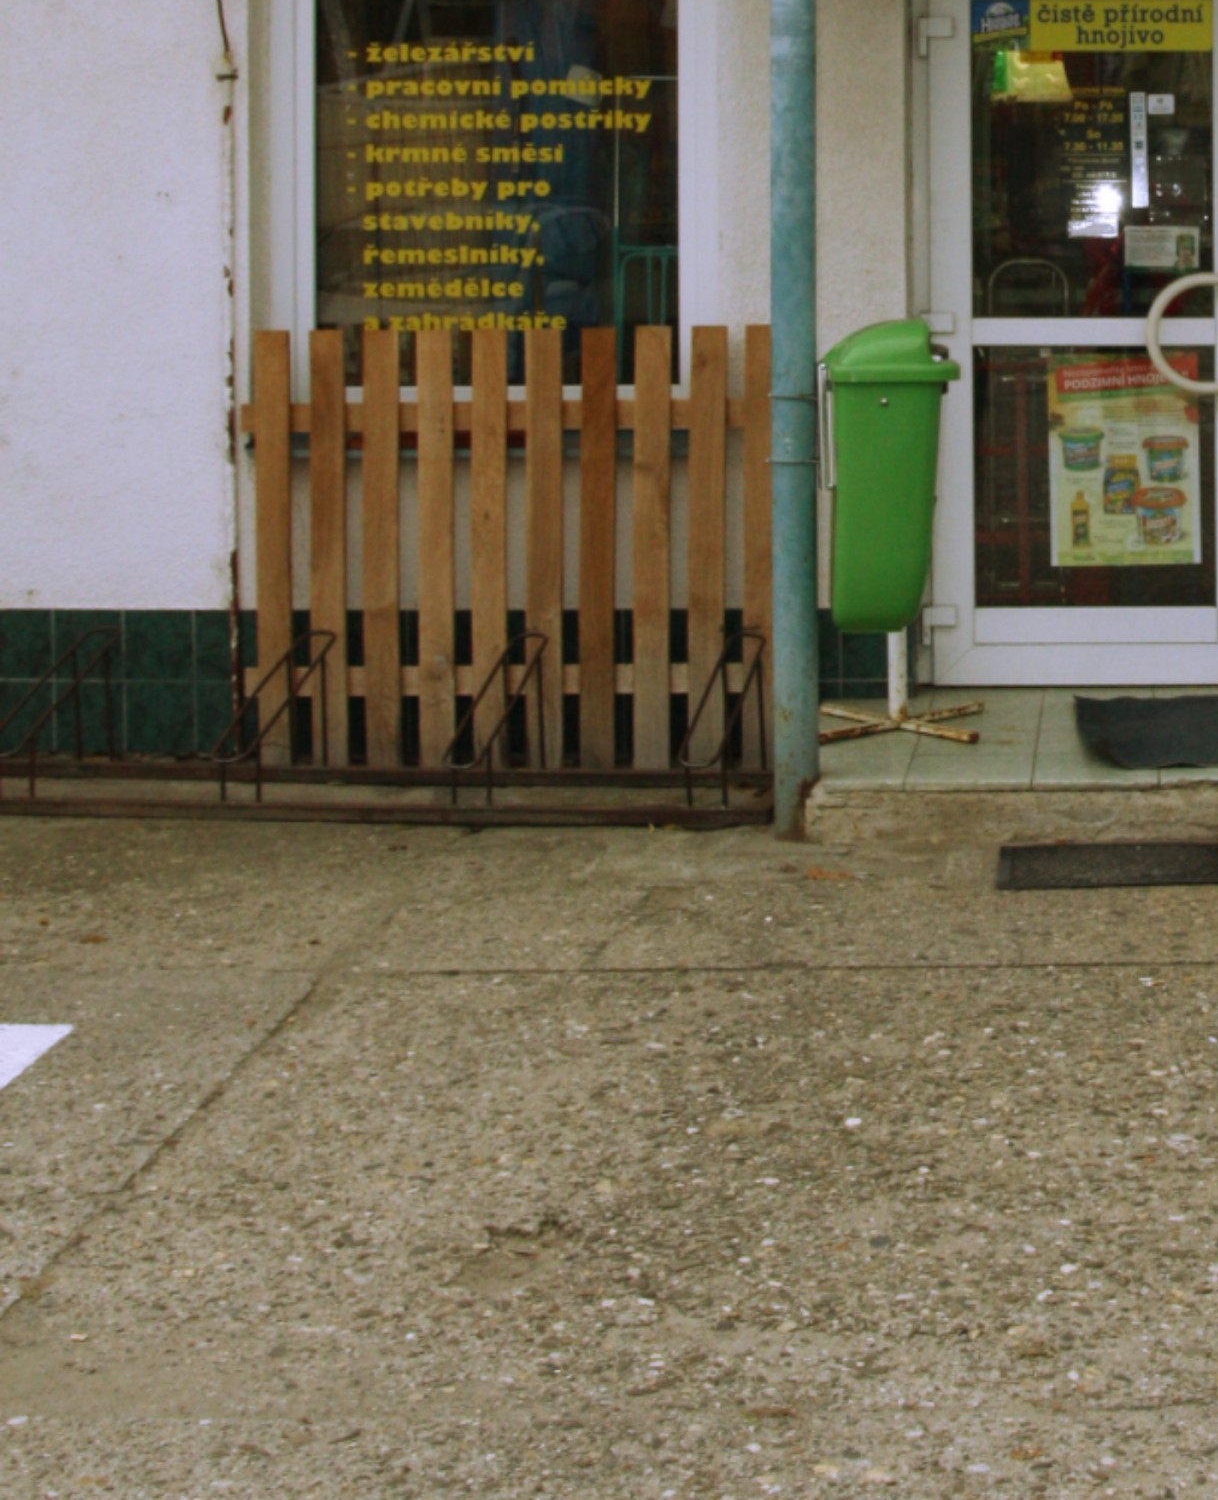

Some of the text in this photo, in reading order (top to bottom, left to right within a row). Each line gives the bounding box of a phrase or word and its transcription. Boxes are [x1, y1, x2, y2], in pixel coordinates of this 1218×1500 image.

[1037, 3, 1095, 24] čistě
[1104, 3, 1204, 27] přírodní
[1076, 26, 1165, 49] hnojivo
[365, 40, 535, 64] železářství
[365, 75, 502, 100] pracovní
[510, 74, 652, 100] pomůcky
[365, 107, 511, 132] chemické
[520, 107, 652, 134] postřiky
[365, 141, 467, 164] krmné
[366, 176, 488, 201] potřeby
[497, 179, 551, 201] pro
[363, 210, 541, 235] stavebníky,
[363, 244, 546, 268] řemeslníky,
[363, 276, 523, 299] zemědělce
[363, 311, 567, 332] a zahrádkáře
